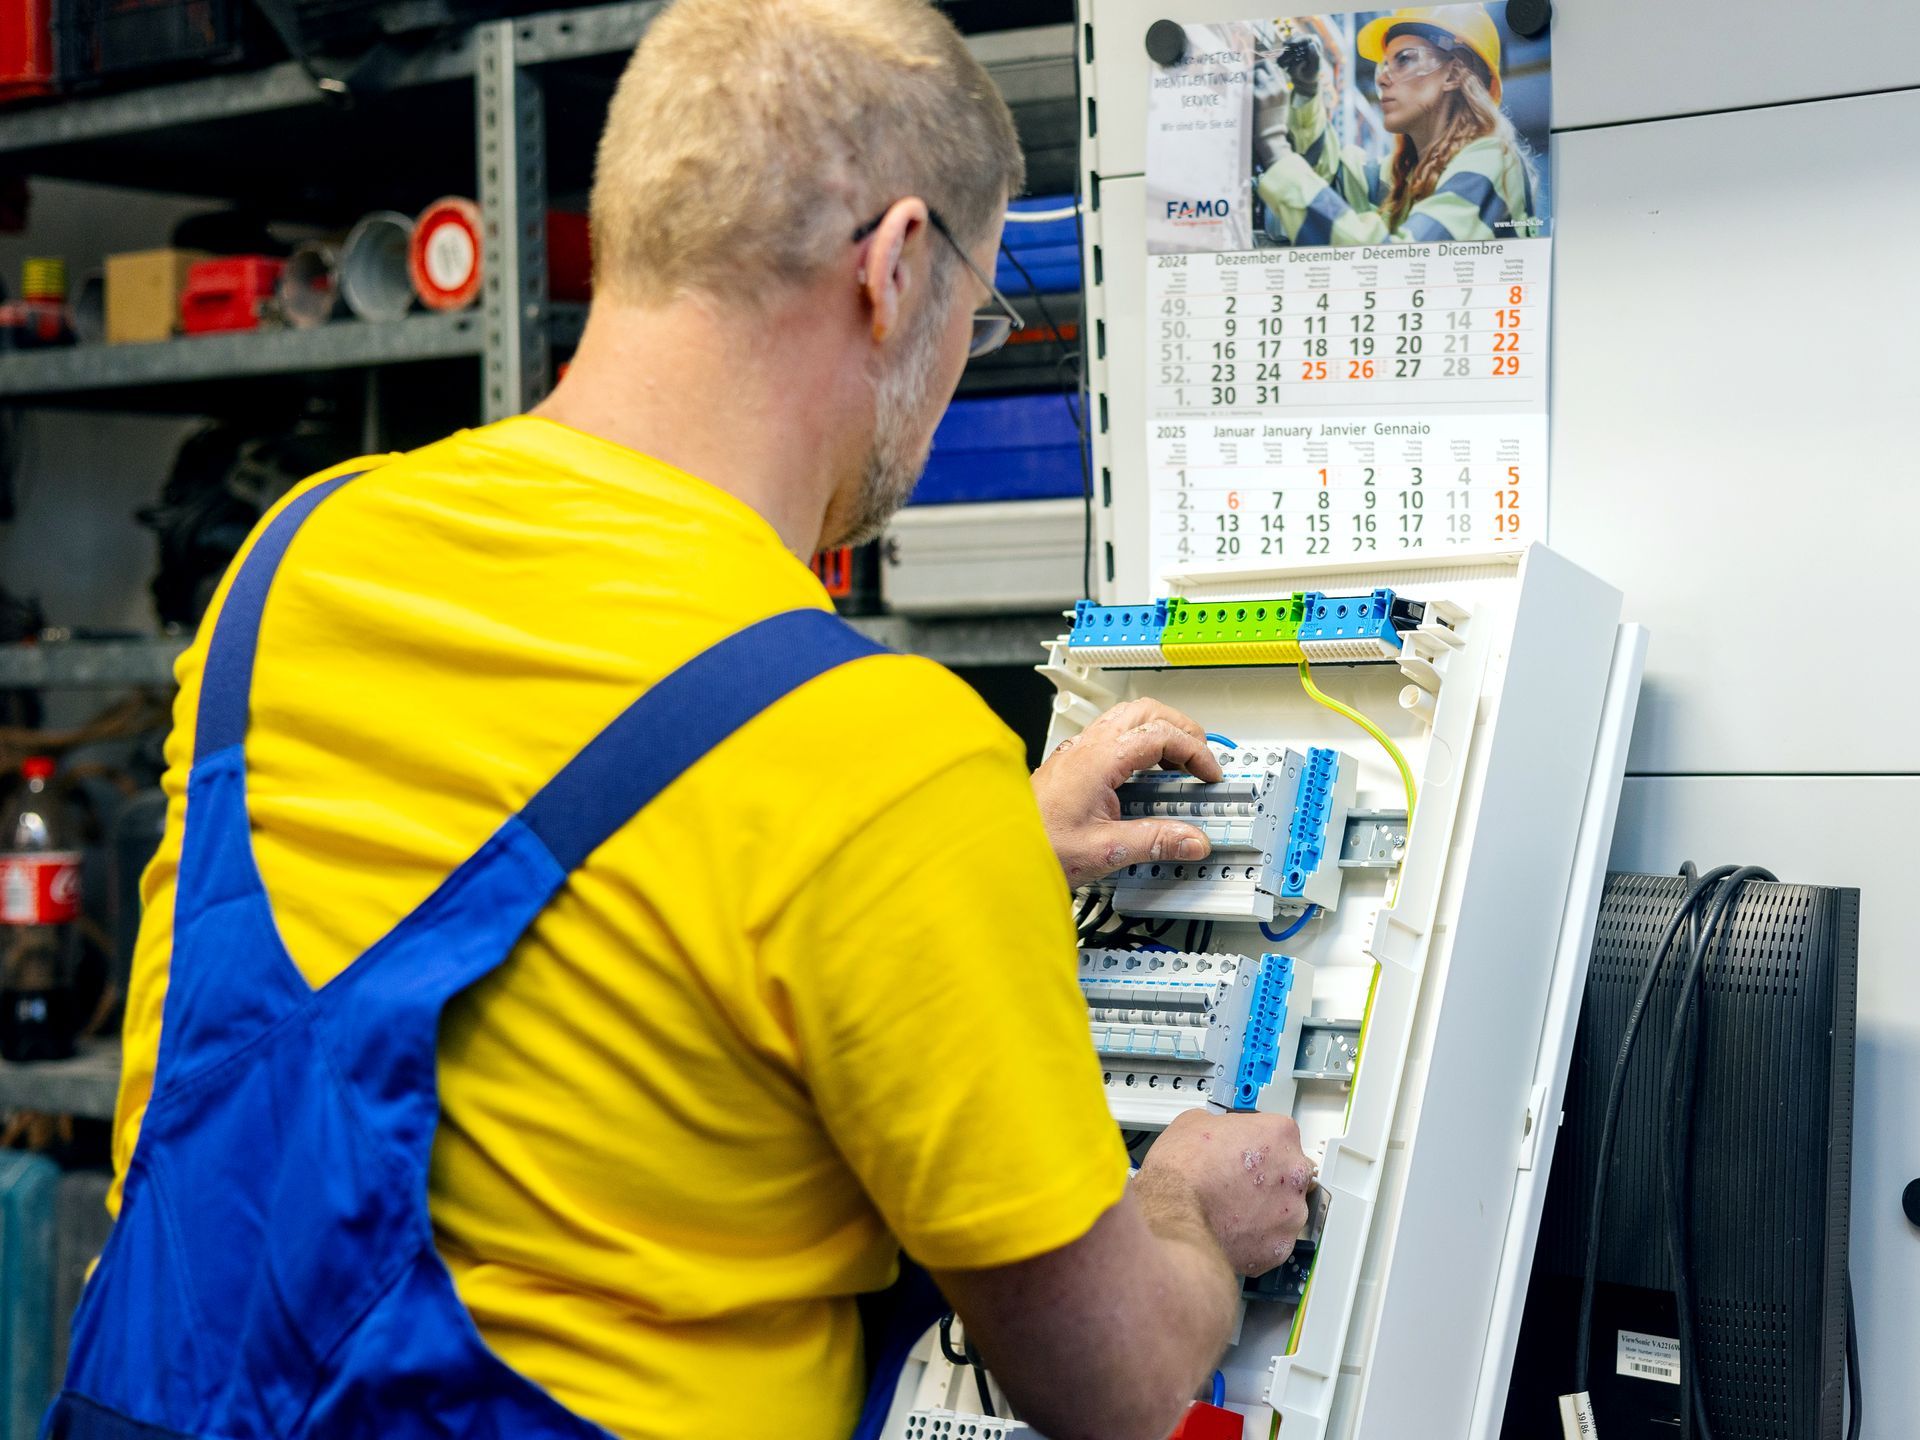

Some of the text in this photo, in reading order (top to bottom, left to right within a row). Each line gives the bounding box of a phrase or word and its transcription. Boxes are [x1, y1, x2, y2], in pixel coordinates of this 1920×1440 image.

[1166, 199, 1229, 219] FAMO
[1158, 241, 1504, 268] 2024 Dezember December Décembre Dicembre
[1161, 286, 1522, 316] 49. 2 3 4 5 6 7 8
[1162, 310, 1520, 339] 50. 9 10 11 12 13 14 15
[1162, 333, 1519, 362] 51. 16 17 18 19 20 21 22
[1162, 356, 1519, 384] 52. 23 24 25 26 27 28 29
[1175, 386, 1278, 406] 1. 30 31
[1157, 422, 1430, 439] 2025 Januar January Janvier Gennaio
[1177, 467, 1519, 487] 1. 1 2 3 4 5
[1178, 490, 1519, 510] 2. 6 7 8 9 10 11 12
[1178, 514, 1520, 533] 3. 13 14 15 16 17 18 19
[1178, 536, 1195, 554] 4.
[1217, 537, 1240, 554] 20
[1261, 537, 1282, 554] 21
[1307, 537, 1329, 554] 22
[1353, 537, 1376, 551] 23
[1621, 1335, 1650, 1347] ViewSonic
[1577, 1411, 1590, 1434] 39/86
